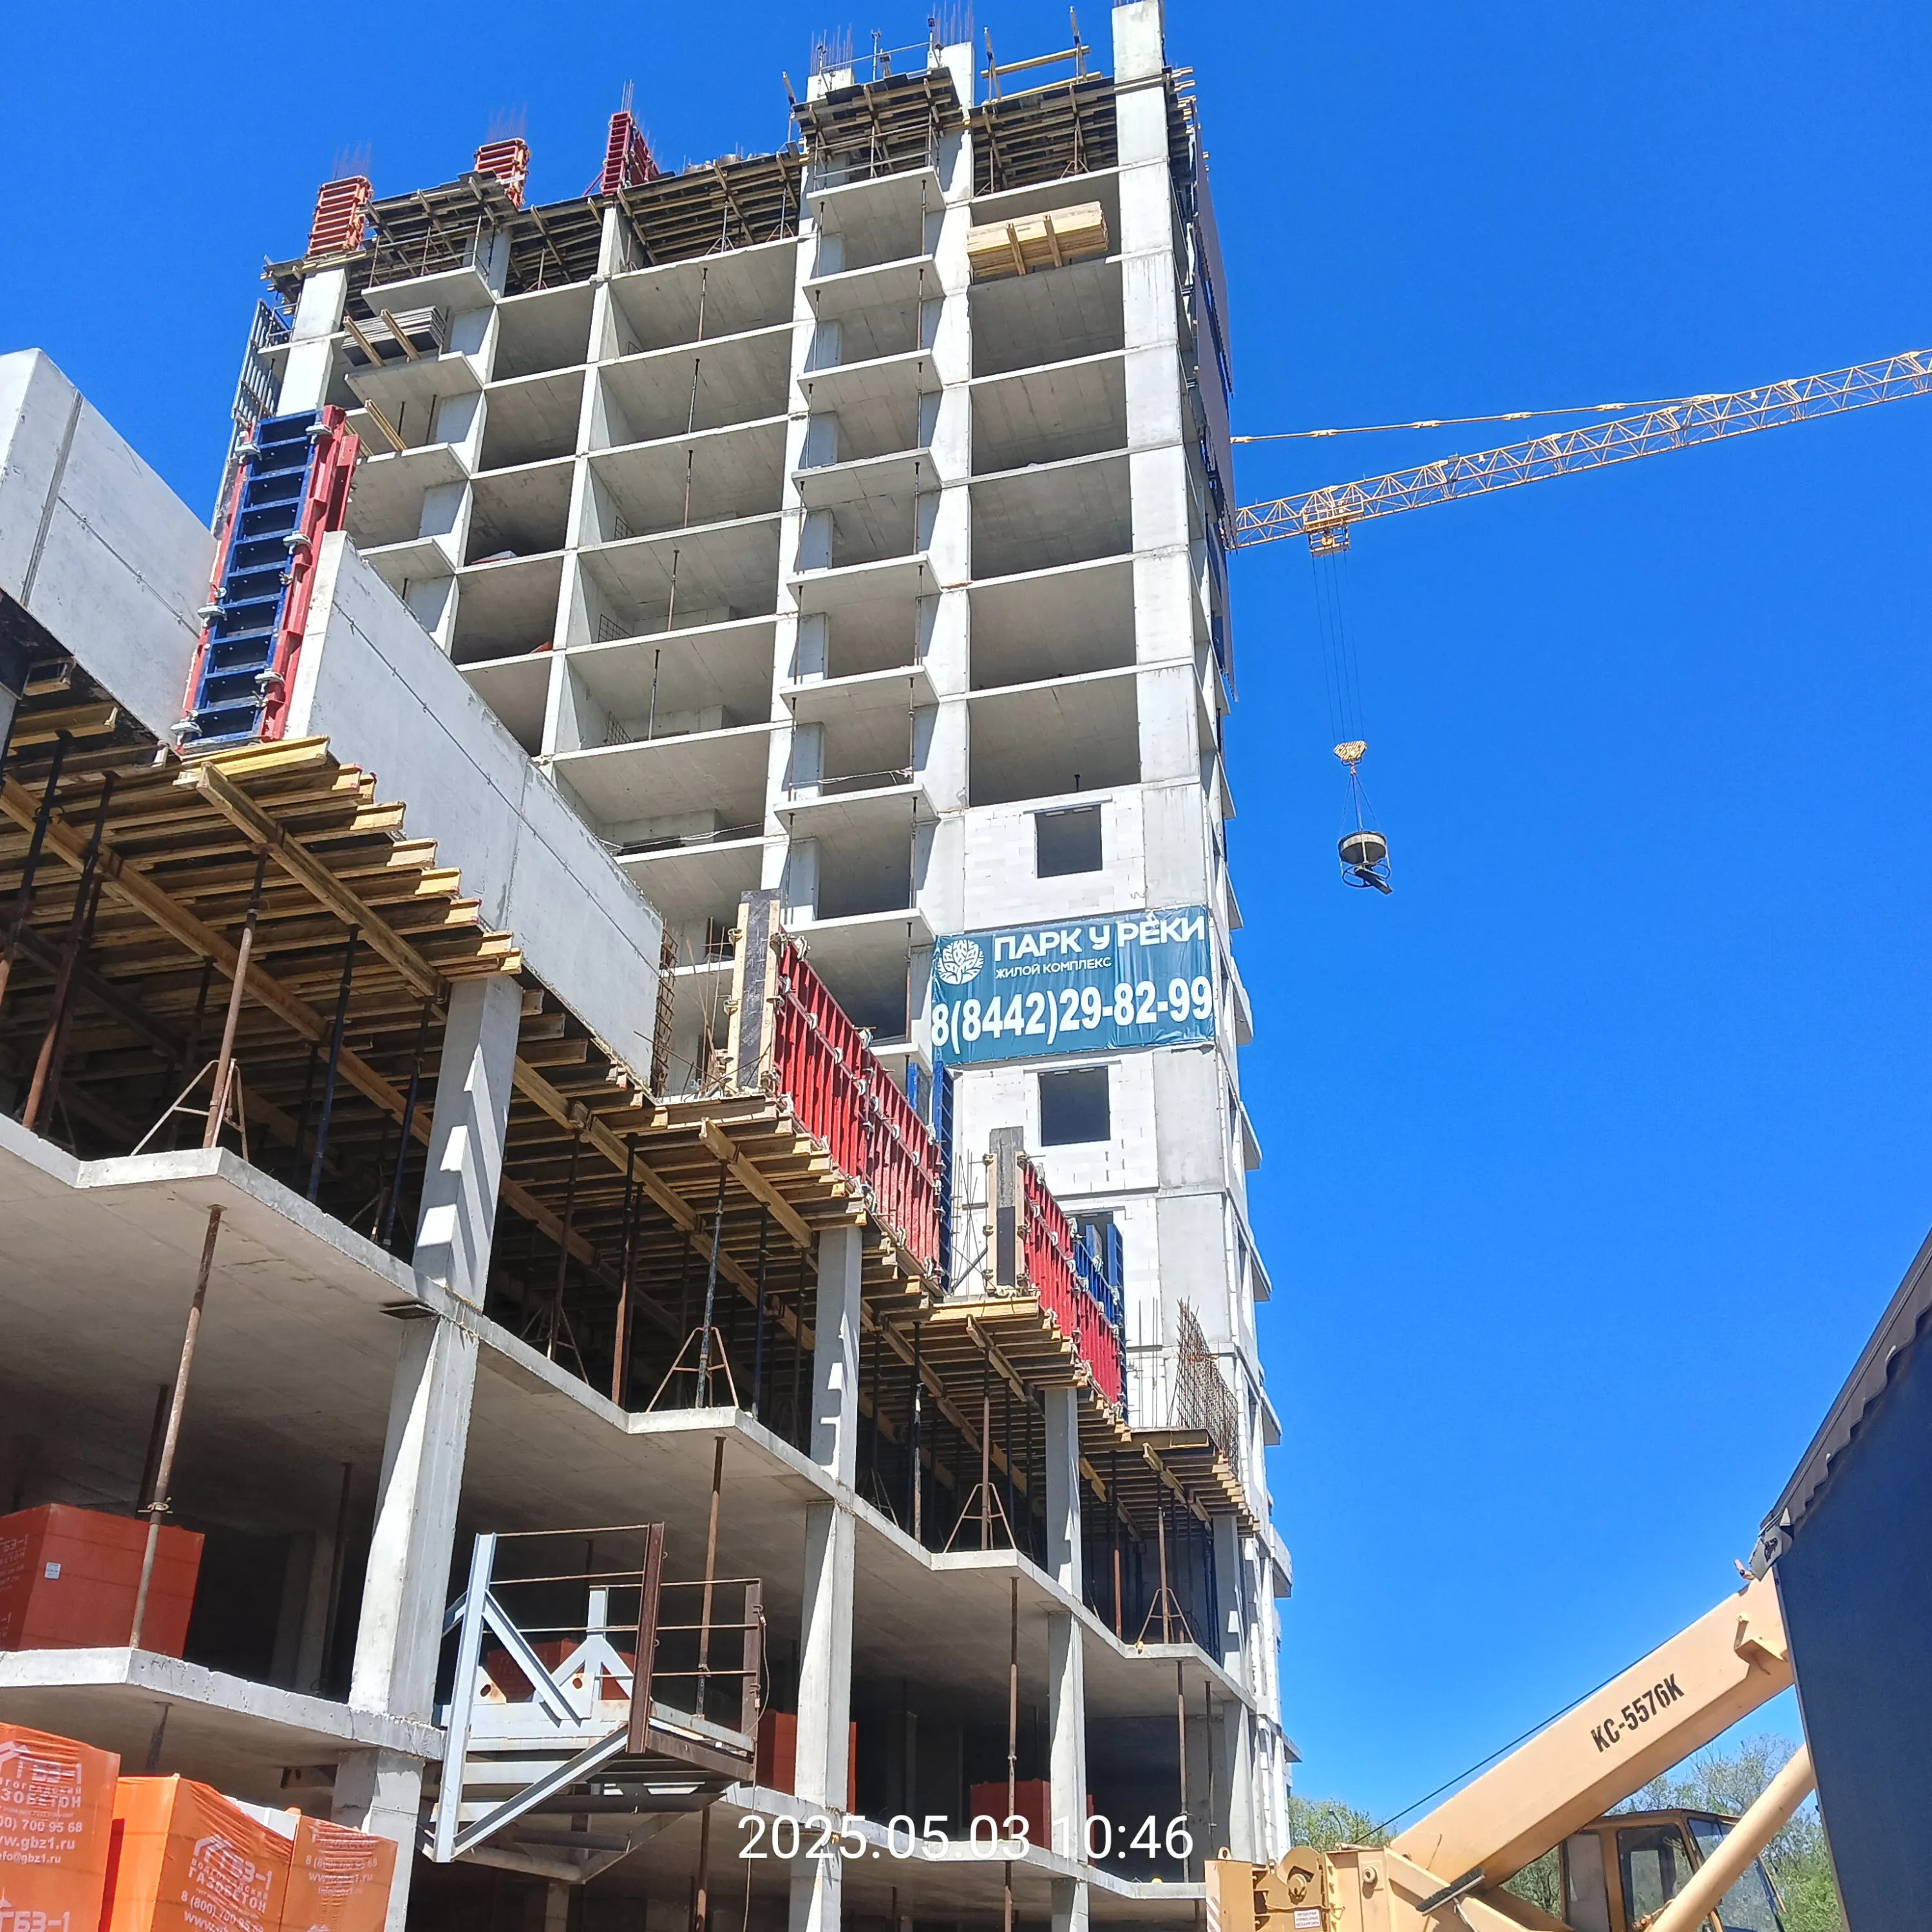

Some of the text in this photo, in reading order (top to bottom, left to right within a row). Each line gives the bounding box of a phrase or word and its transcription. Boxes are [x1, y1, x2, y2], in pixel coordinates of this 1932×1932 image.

[994, 915, 1206, 962] ПАРК У РЕКИ
[995, 957, 1113, 980] ЖИЛОЙ КОМПЛЕКС
[931, 976, 1213, 1054] 8(8442)29-82-99
[22, 1819, 45, 1833] 700
[48, 1821, 64, 1833] 95
[67, 1821, 83, 1833] 68
[305, 1855, 312, 1866] 8
[180, 1890, 189, 1902] 8
[190, 1895, 216, 1917] (800)
